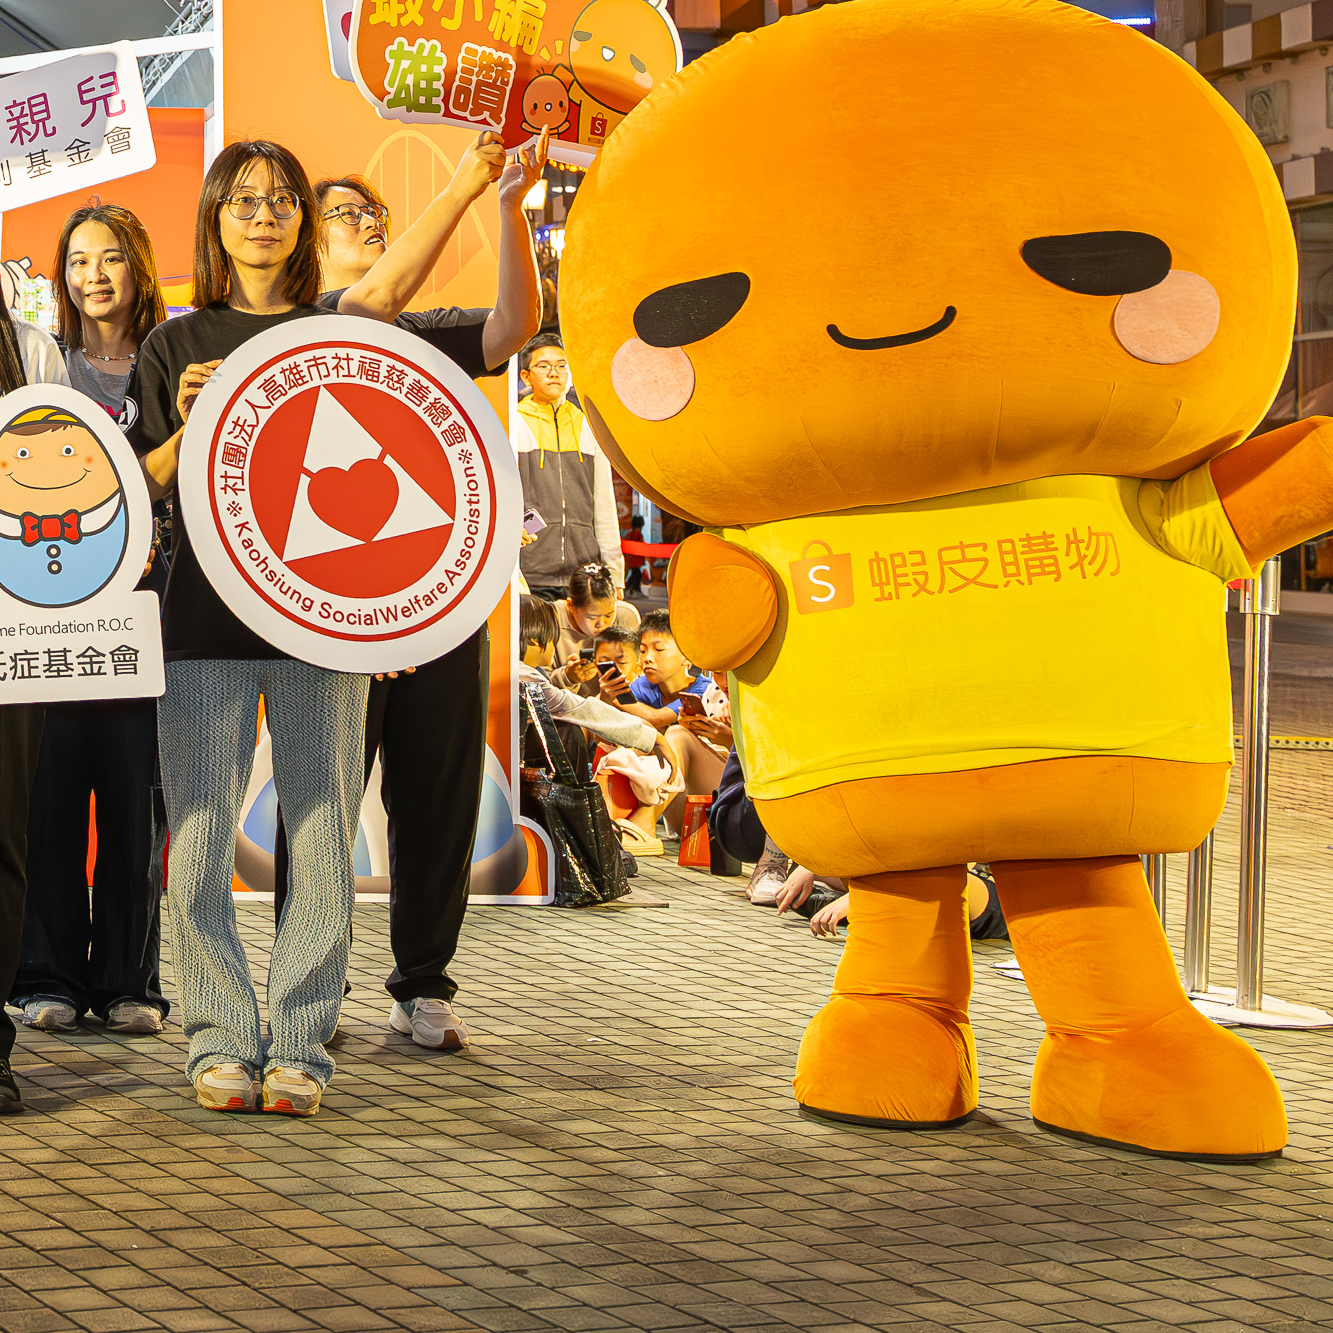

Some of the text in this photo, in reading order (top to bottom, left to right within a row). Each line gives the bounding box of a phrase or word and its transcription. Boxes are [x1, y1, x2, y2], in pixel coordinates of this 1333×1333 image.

[386, 41, 516, 127] 雄讚
[219, 352, 468, 496] 社團法人高雄市社福慈善總會
[234, 520, 315, 613] Kaohsiung
[809, 525, 1123, 604] S 蝦皮購物
[19, 618, 95, 637] Foundation
[97, 617, 134, 633] R.O.C
